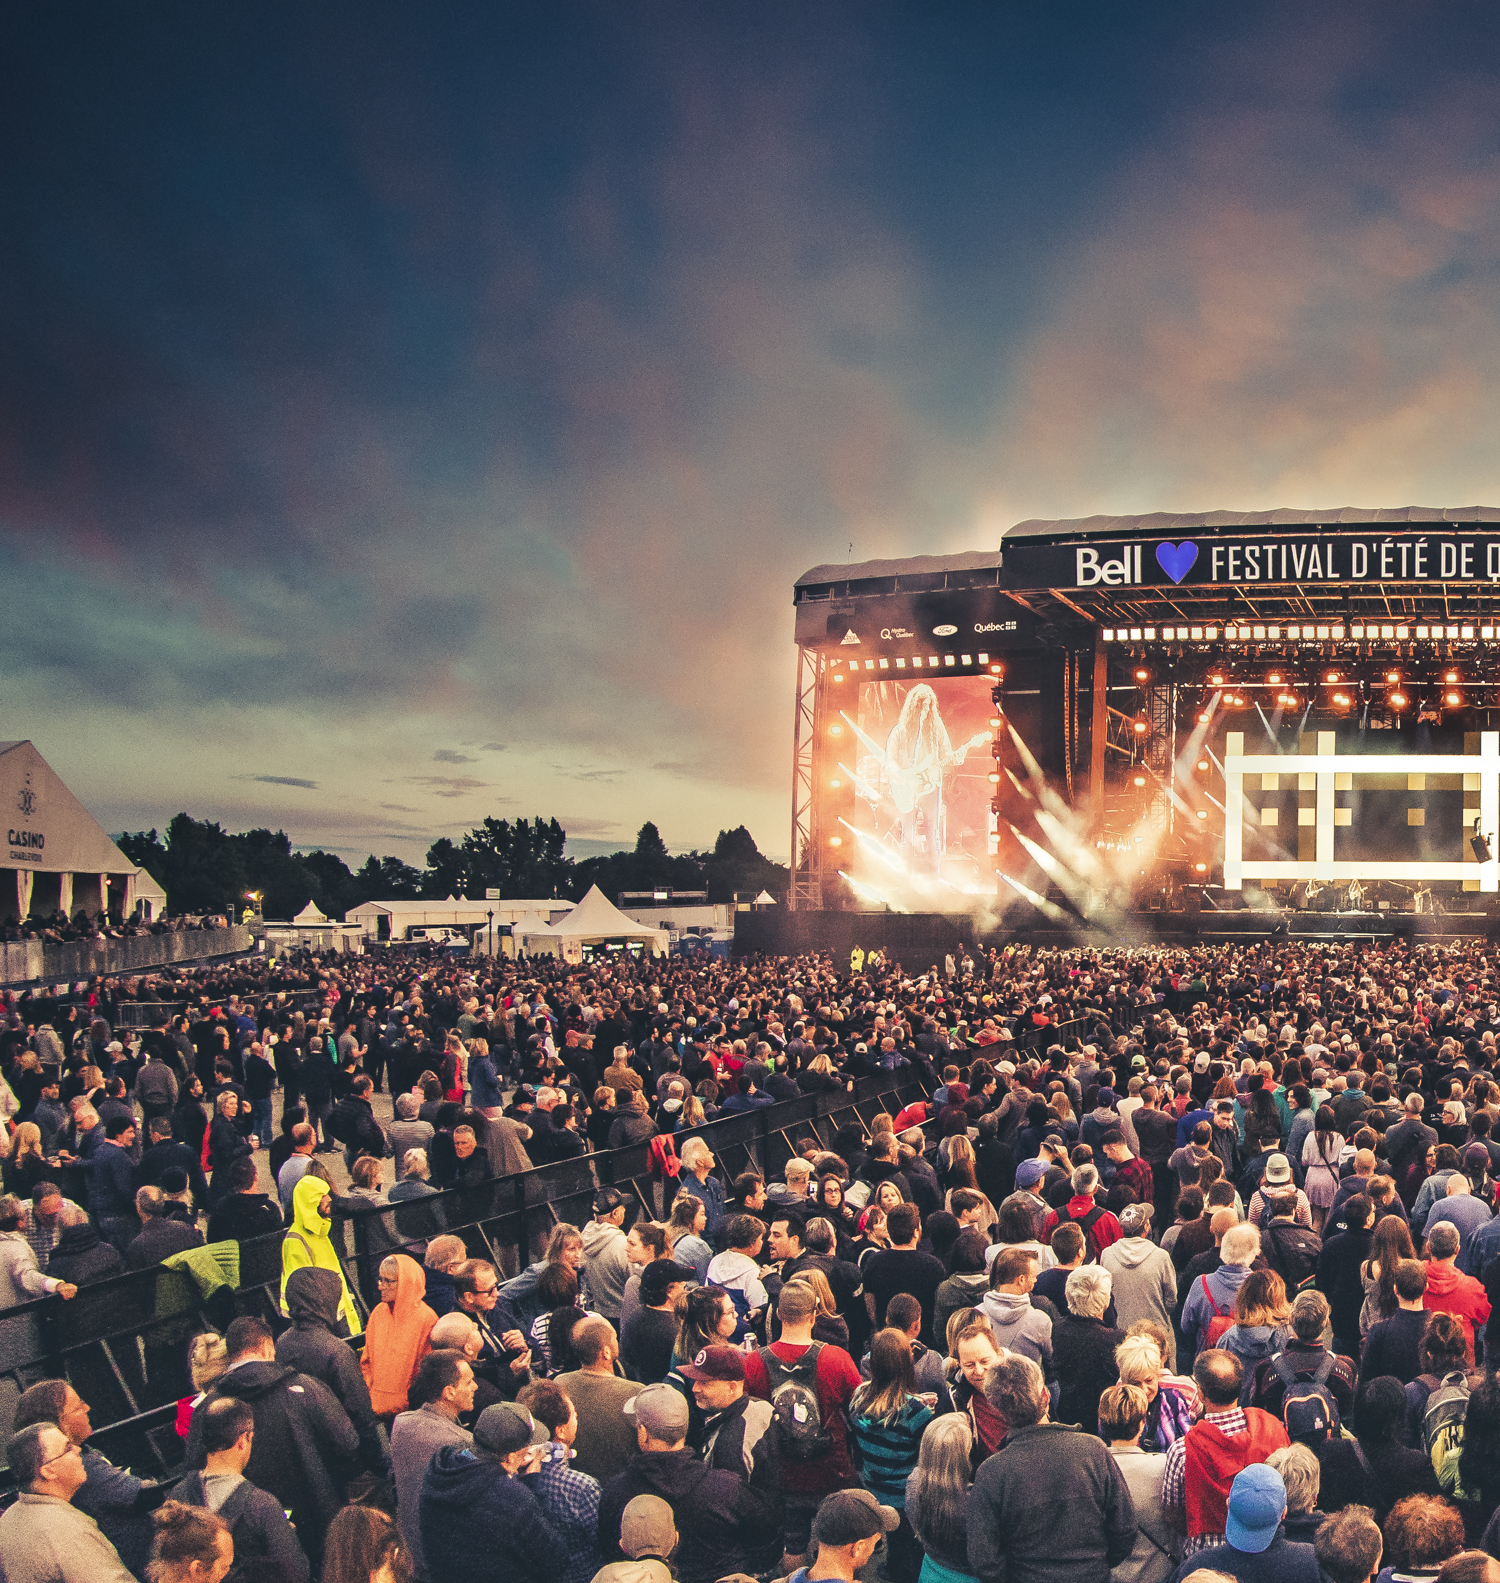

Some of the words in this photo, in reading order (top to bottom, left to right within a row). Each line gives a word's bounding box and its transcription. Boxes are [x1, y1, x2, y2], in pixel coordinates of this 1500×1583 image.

[1076, 545, 1142, 586] Bell
[1211, 543, 1340, 581] FESTIVAL
[1351, 537, 1428, 578] D'ÉTÉ
[1440, 542, 1474, 578] DE
[974, 622, 1005, 633] Québec
[8, 829, 45, 849] CASINO
